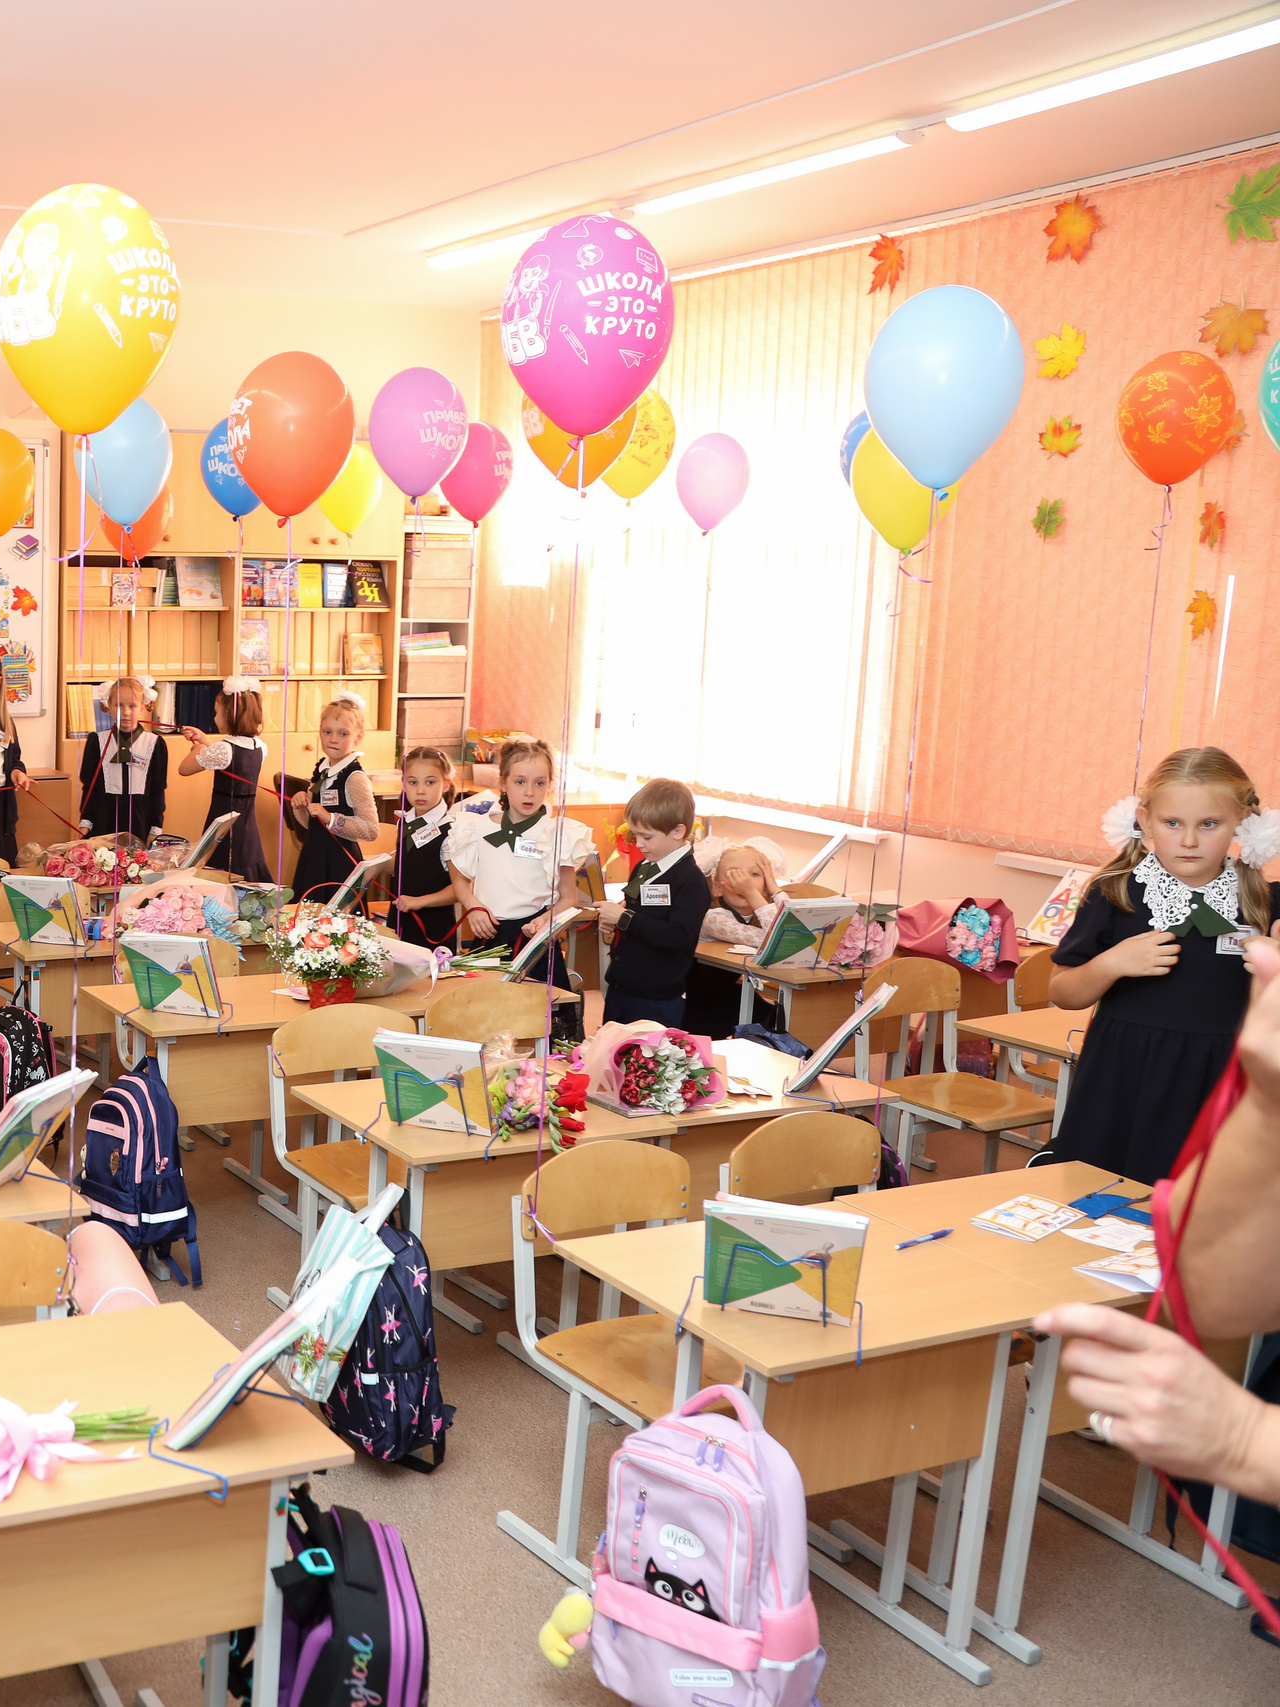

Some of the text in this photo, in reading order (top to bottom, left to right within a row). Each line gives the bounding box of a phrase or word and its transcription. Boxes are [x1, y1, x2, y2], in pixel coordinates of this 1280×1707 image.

[576, 271, 663, 304] ШКОЛА
[119, 294, 177, 322] КРУТО
[584, 314, 657, 340] КРУТО
